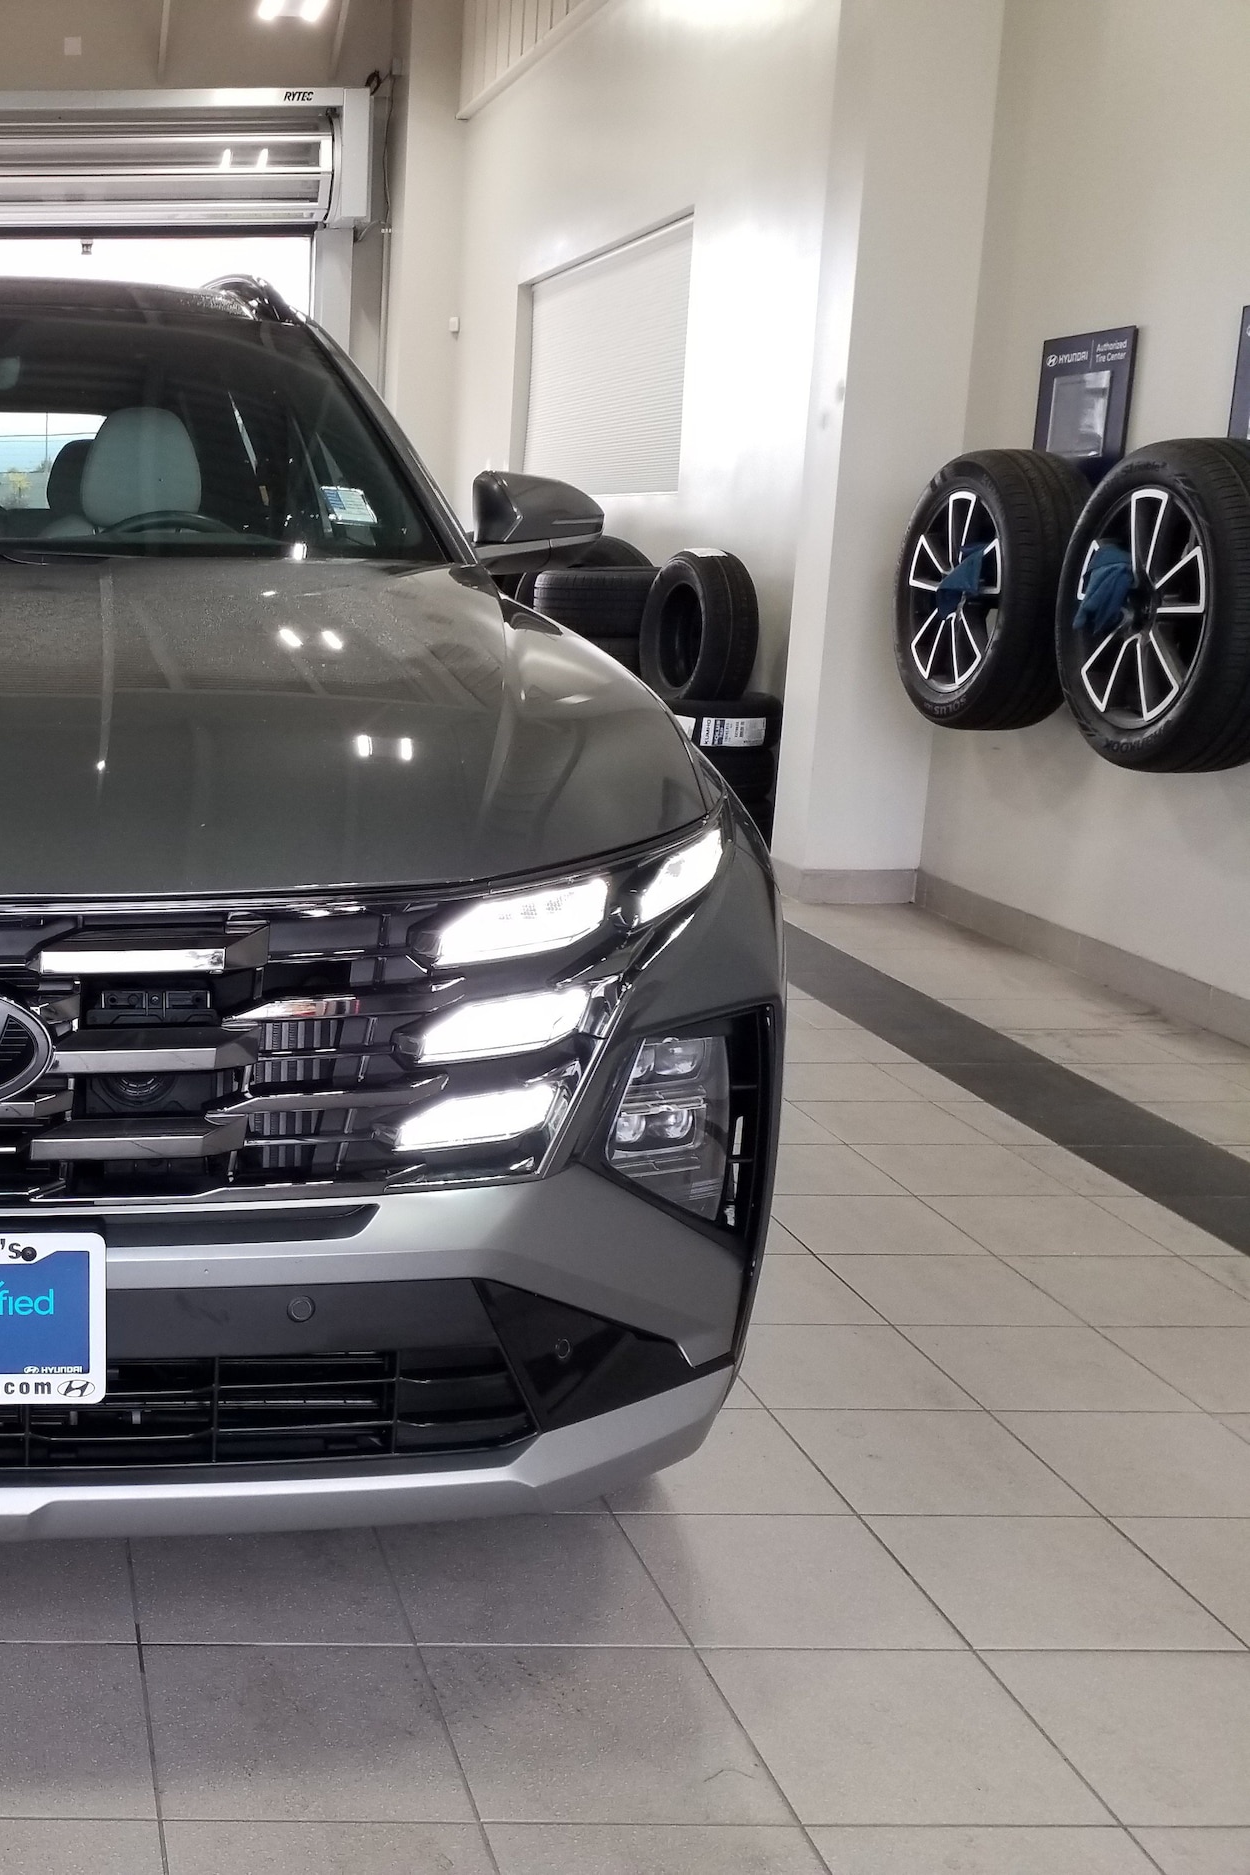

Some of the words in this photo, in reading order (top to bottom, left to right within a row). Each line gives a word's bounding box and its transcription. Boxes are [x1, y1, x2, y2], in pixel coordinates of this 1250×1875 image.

[284, 91, 314, 101] RYTEC
[1096, 340, 1127, 352] Authorized
[1058, 351, 1088, 364] HYUNDAI
[1095, 353, 1106, 362] Tire
[1106, 352, 1126, 362] Center
[704, 719, 712, 745] KUMHO
[41, 1366, 83, 1374] HYUNDAI
